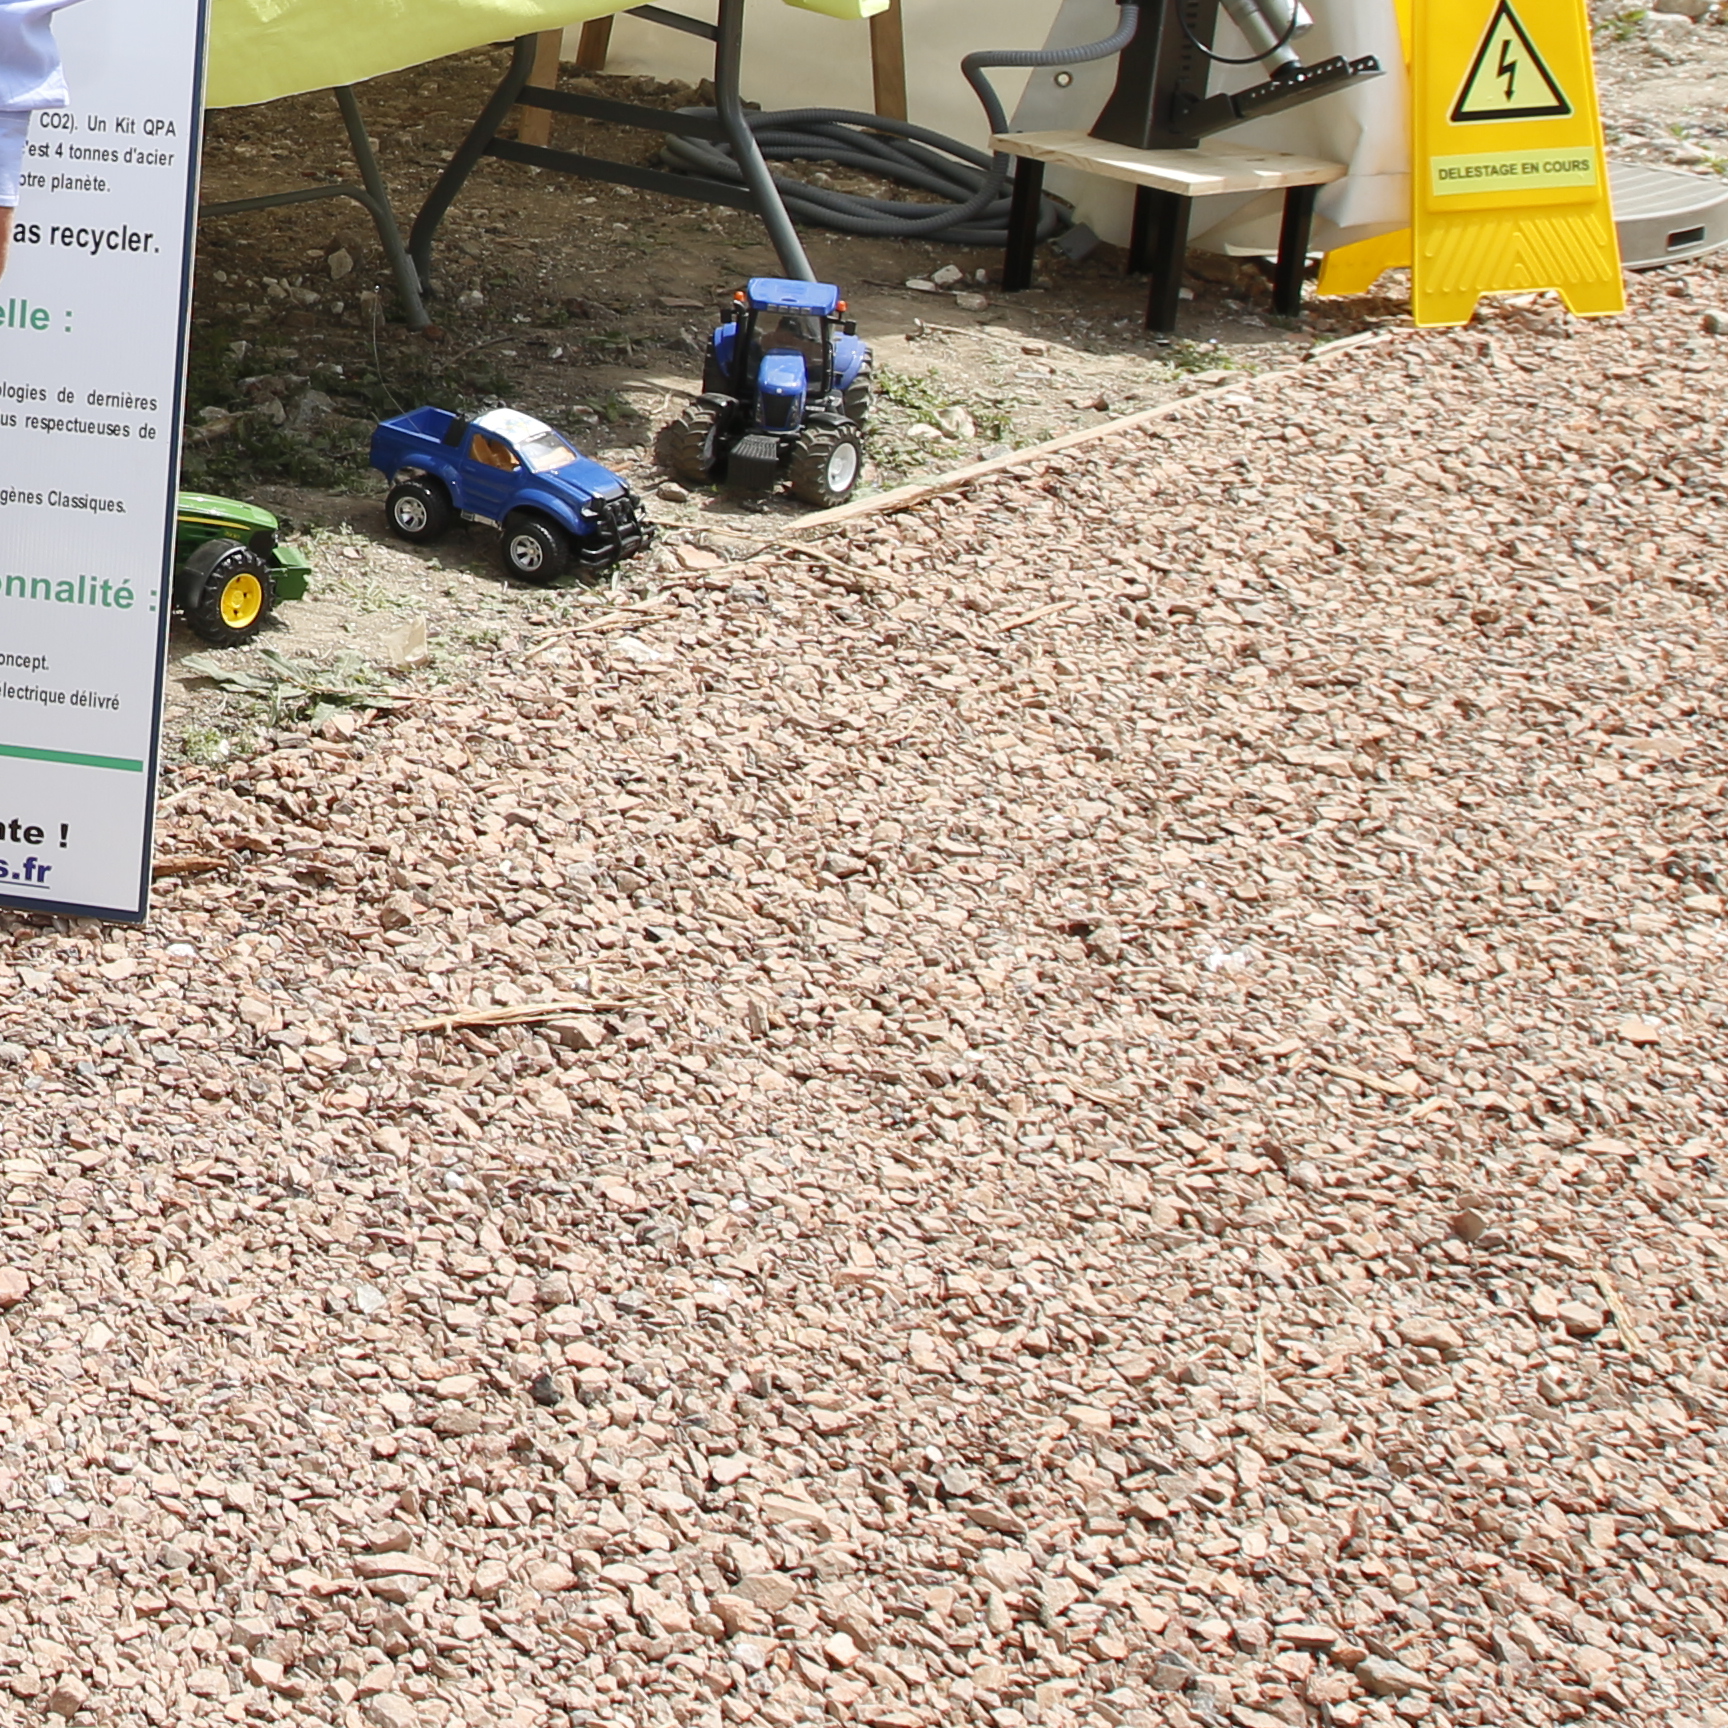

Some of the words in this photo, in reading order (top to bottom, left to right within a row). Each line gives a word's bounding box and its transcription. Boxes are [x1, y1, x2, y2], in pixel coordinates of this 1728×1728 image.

[87, 114, 106, 132] Un
[115, 116, 135, 134] Kit
[143, 119, 176, 138] QPA
[55, 143, 63, 158] 4
[69, 143, 118, 162] tonnes
[124, 147, 174, 167] d'acier
[1438, 162, 1519, 181] DELESTAGE
[1522, 160, 1540, 176] EN
[1543, 157, 1590, 176] COURS
[12, 222, 41, 244] as
[49, 224, 160, 255] recycler.
[57, 385, 75, 403] de
[87, 388, 158, 411] dernières
[25, 415, 130, 439] respectueuses
[139, 422, 156, 440] de
[47, 489, 127, 516] Classiques.
[69, 686, 121, 711] délivré
